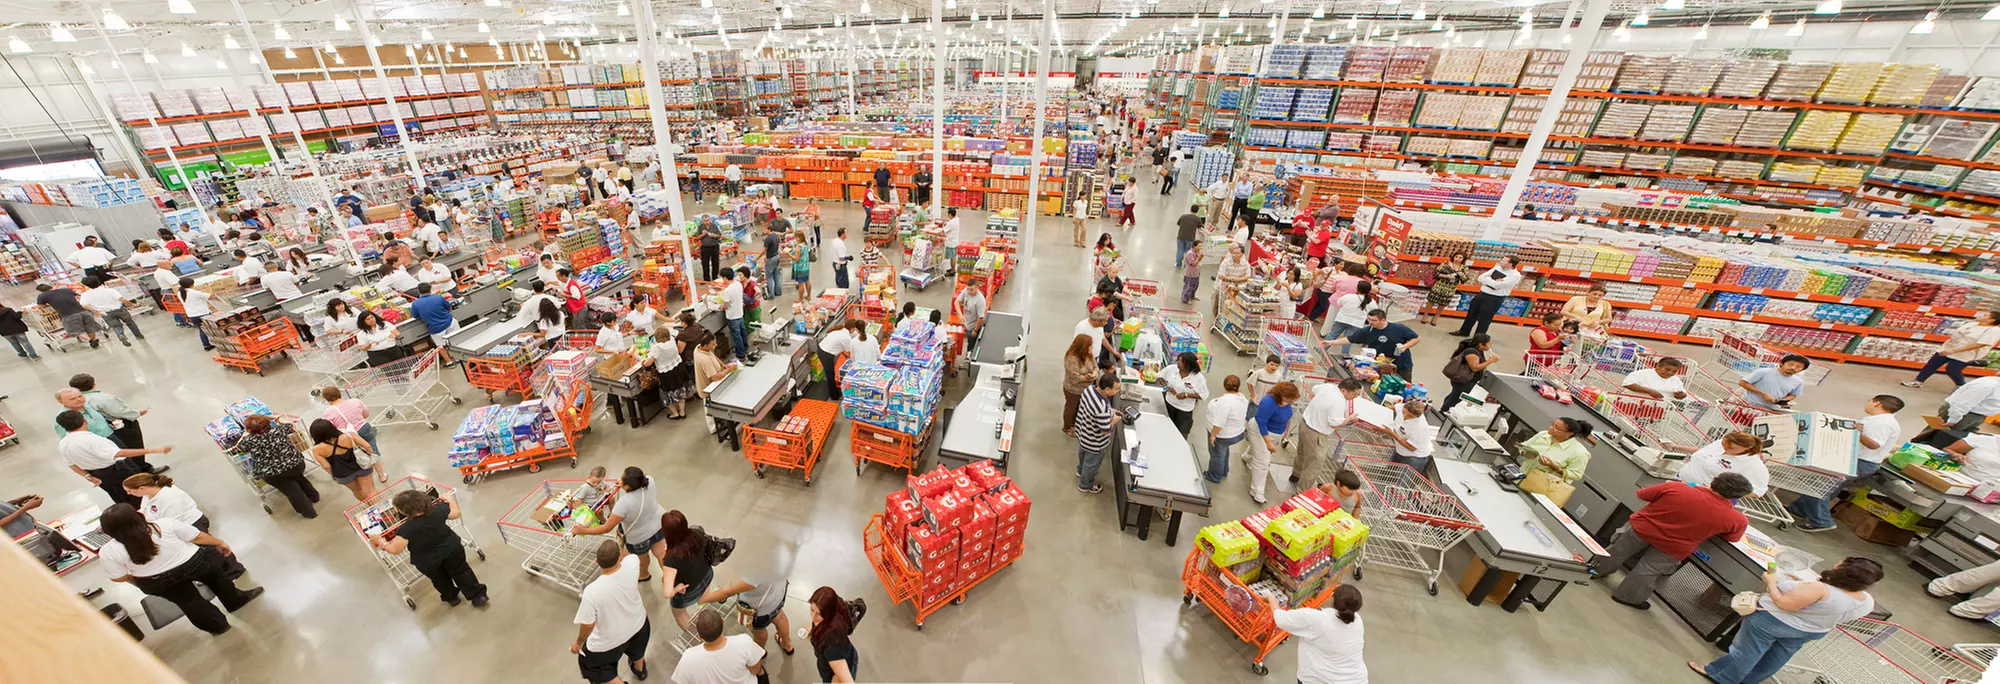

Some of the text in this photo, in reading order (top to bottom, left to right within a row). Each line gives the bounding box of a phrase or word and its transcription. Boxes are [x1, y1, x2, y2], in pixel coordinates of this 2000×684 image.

[980, 466, 995, 477] G
[919, 477, 928, 486] G
[1000, 492, 1017, 505] G
[952, 517, 961, 527] G
[1009, 513, 1018, 522] G
[974, 529, 983, 538] G
[1007, 526, 1016, 534] G
[974, 542, 982, 551] G
[1003, 542, 1011, 551] G
[929, 550, 937, 559] G
[1001, 553, 1009, 562] G
[937, 560, 946, 569] G
[1531, 565, 1549, 575] 12
[934, 575, 942, 584] G
[969, 571, 977, 580] G
[927, 595, 936, 603] G
